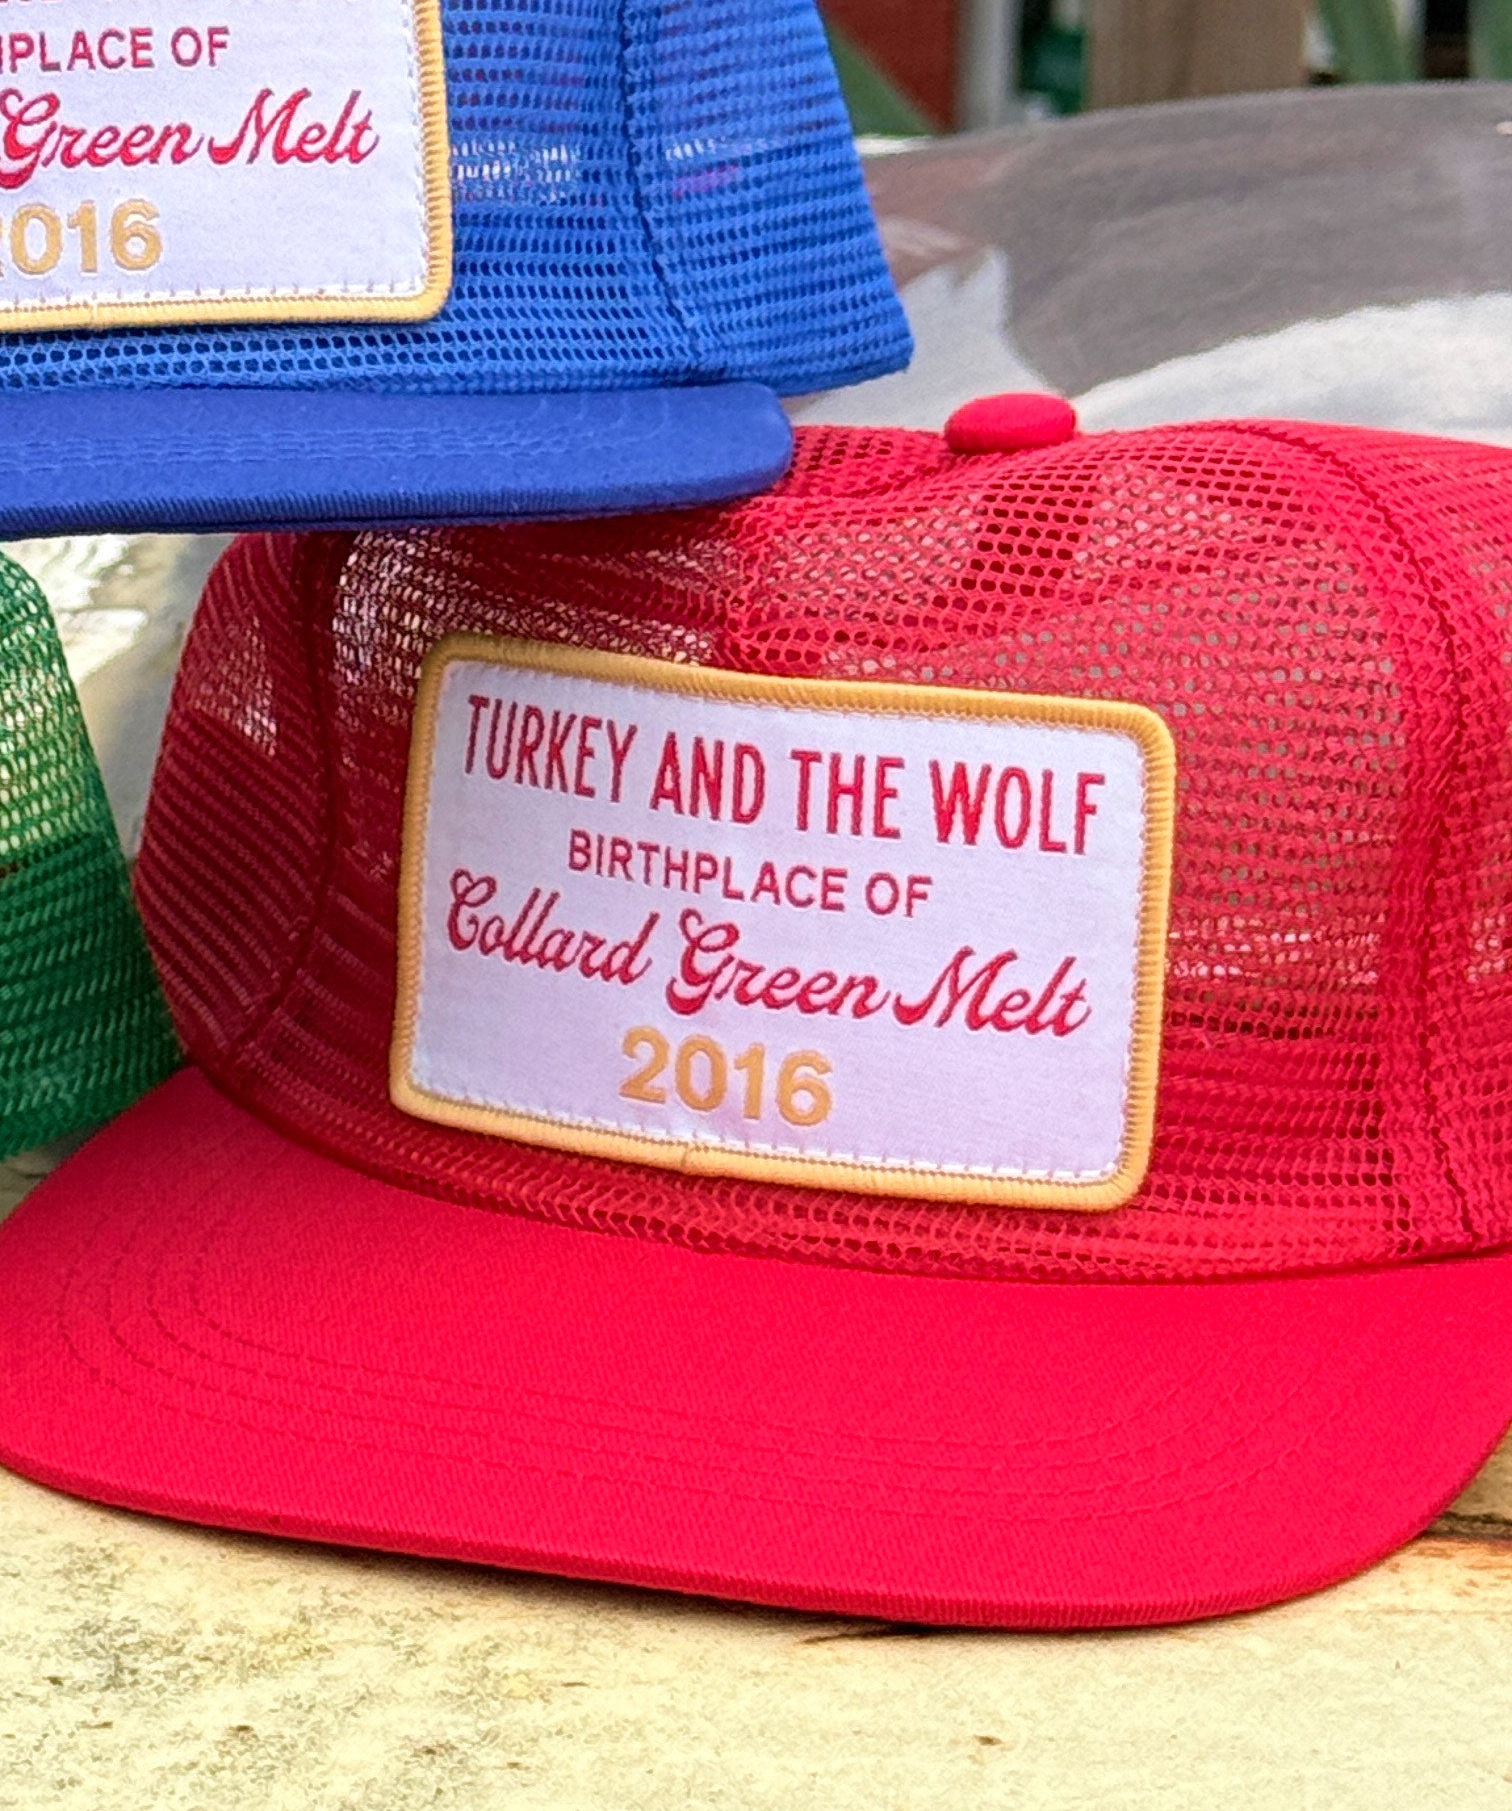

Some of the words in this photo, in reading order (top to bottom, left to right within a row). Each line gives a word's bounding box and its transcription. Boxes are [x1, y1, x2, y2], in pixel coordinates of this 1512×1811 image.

[172, 27, 228, 67] OF
[208, 88, 380, 165] Melt
[464, 693, 638, 803] TURKEY
[649, 731, 767, 826] AND
[788, 748, 906, 840] THE
[928, 759, 1106, 857] WOLF
[567, 829, 848, 912] BIRTHPLACE
[865, 871, 933, 918] OF
[446, 868, 661, 986] Collard
[665, 907, 891, 1018] Green
[892, 945, 1090, 1037] Melt
[618, 1026, 834, 1127] 2016
